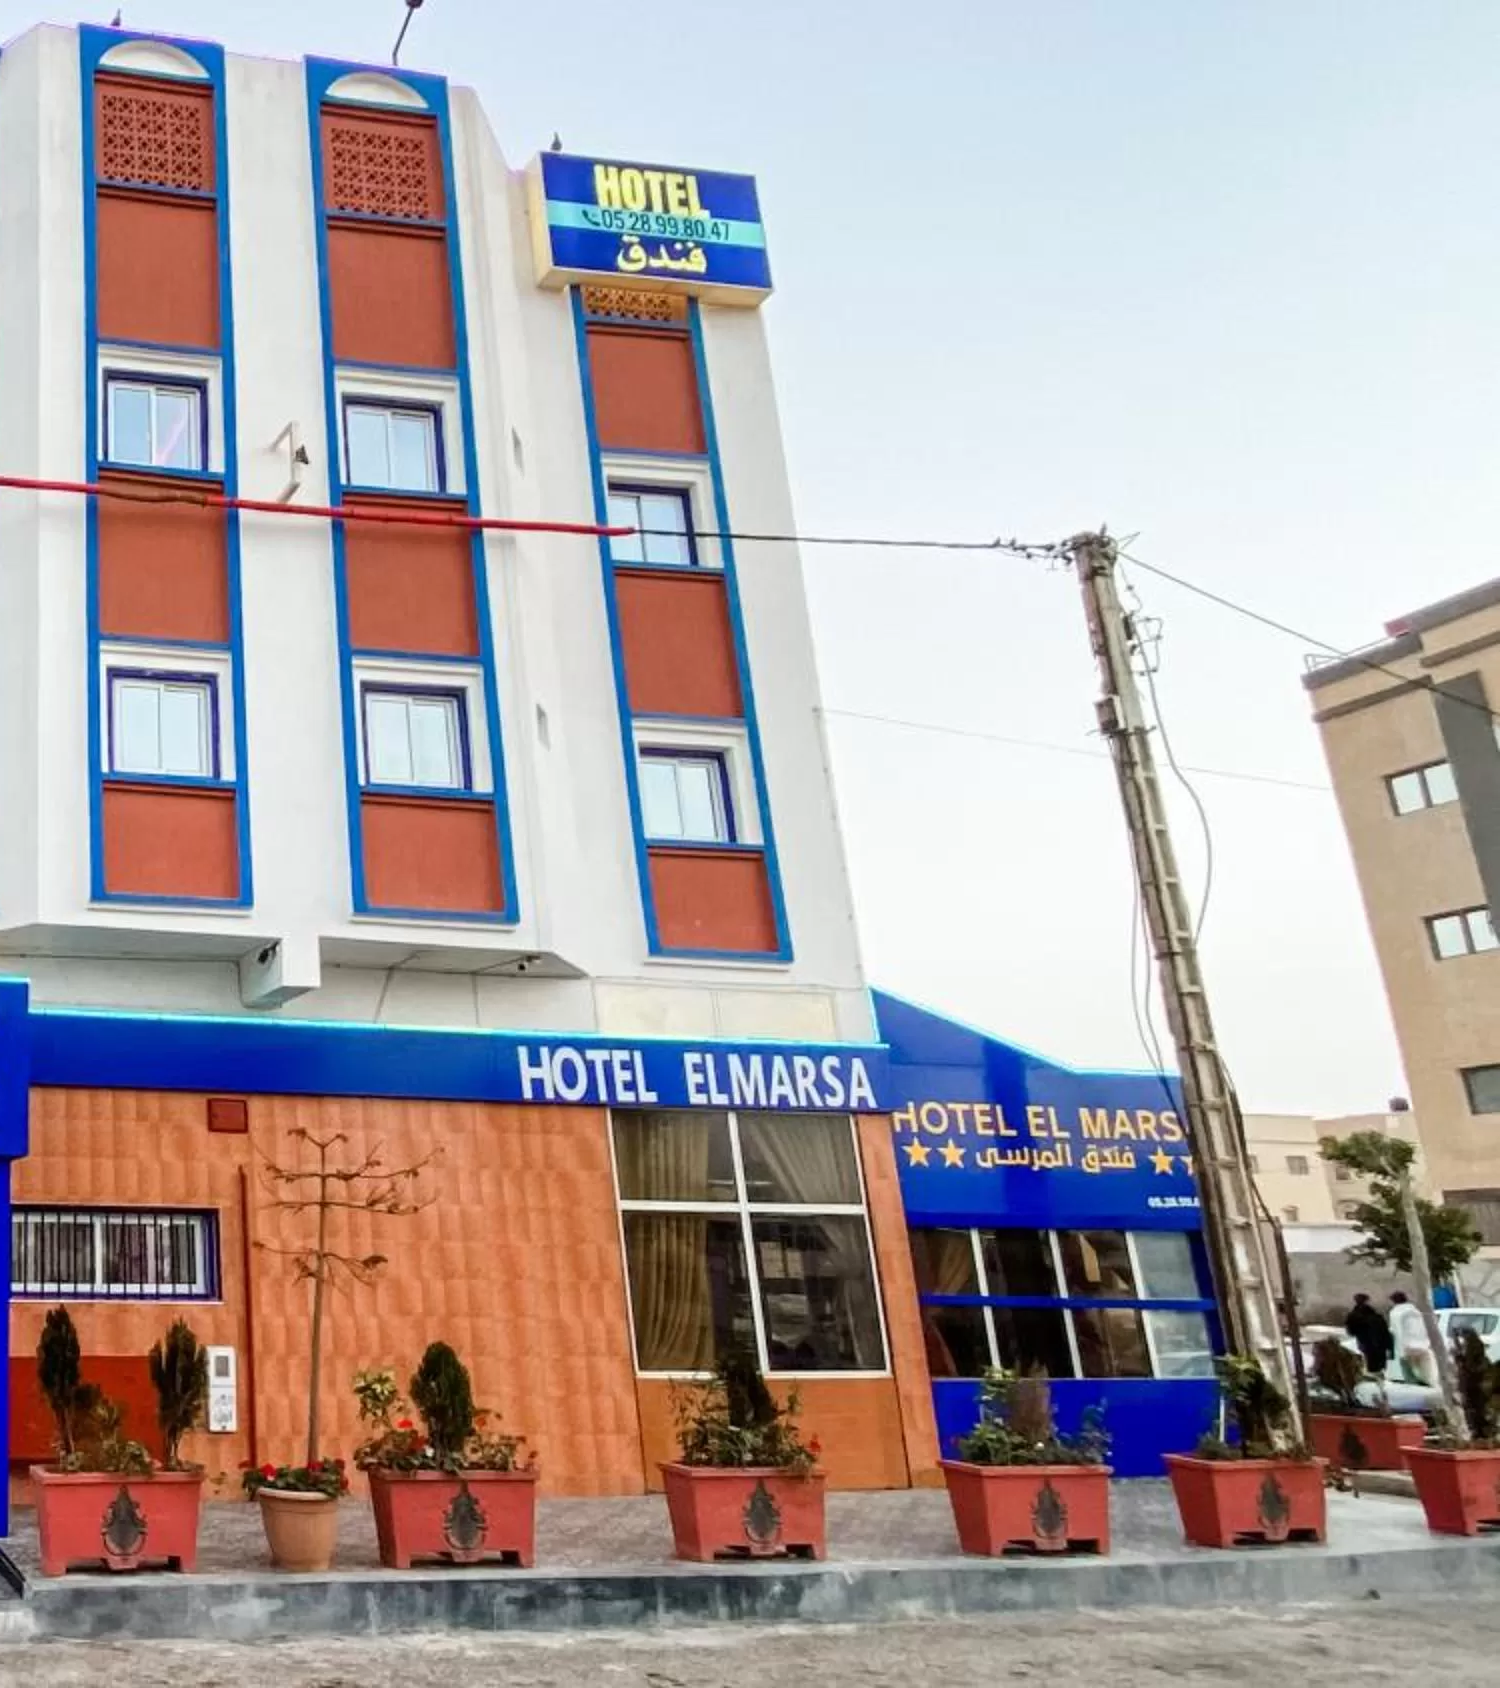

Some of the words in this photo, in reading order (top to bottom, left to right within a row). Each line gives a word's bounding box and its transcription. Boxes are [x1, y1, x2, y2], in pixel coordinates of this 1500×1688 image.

[593, 164, 711, 220] HOTEL
[617, 234, 707, 274] فندق
[516, 1045, 659, 1104] HOTEL
[892, 1101, 1018, 1137] HOTEL
[1025, 1105, 1071, 1138] EL
[1078, 1107, 1190, 1142] MARS
[975, 1142, 1073, 1171] المرسى
[1081, 1143, 1137, 1173] فندق
